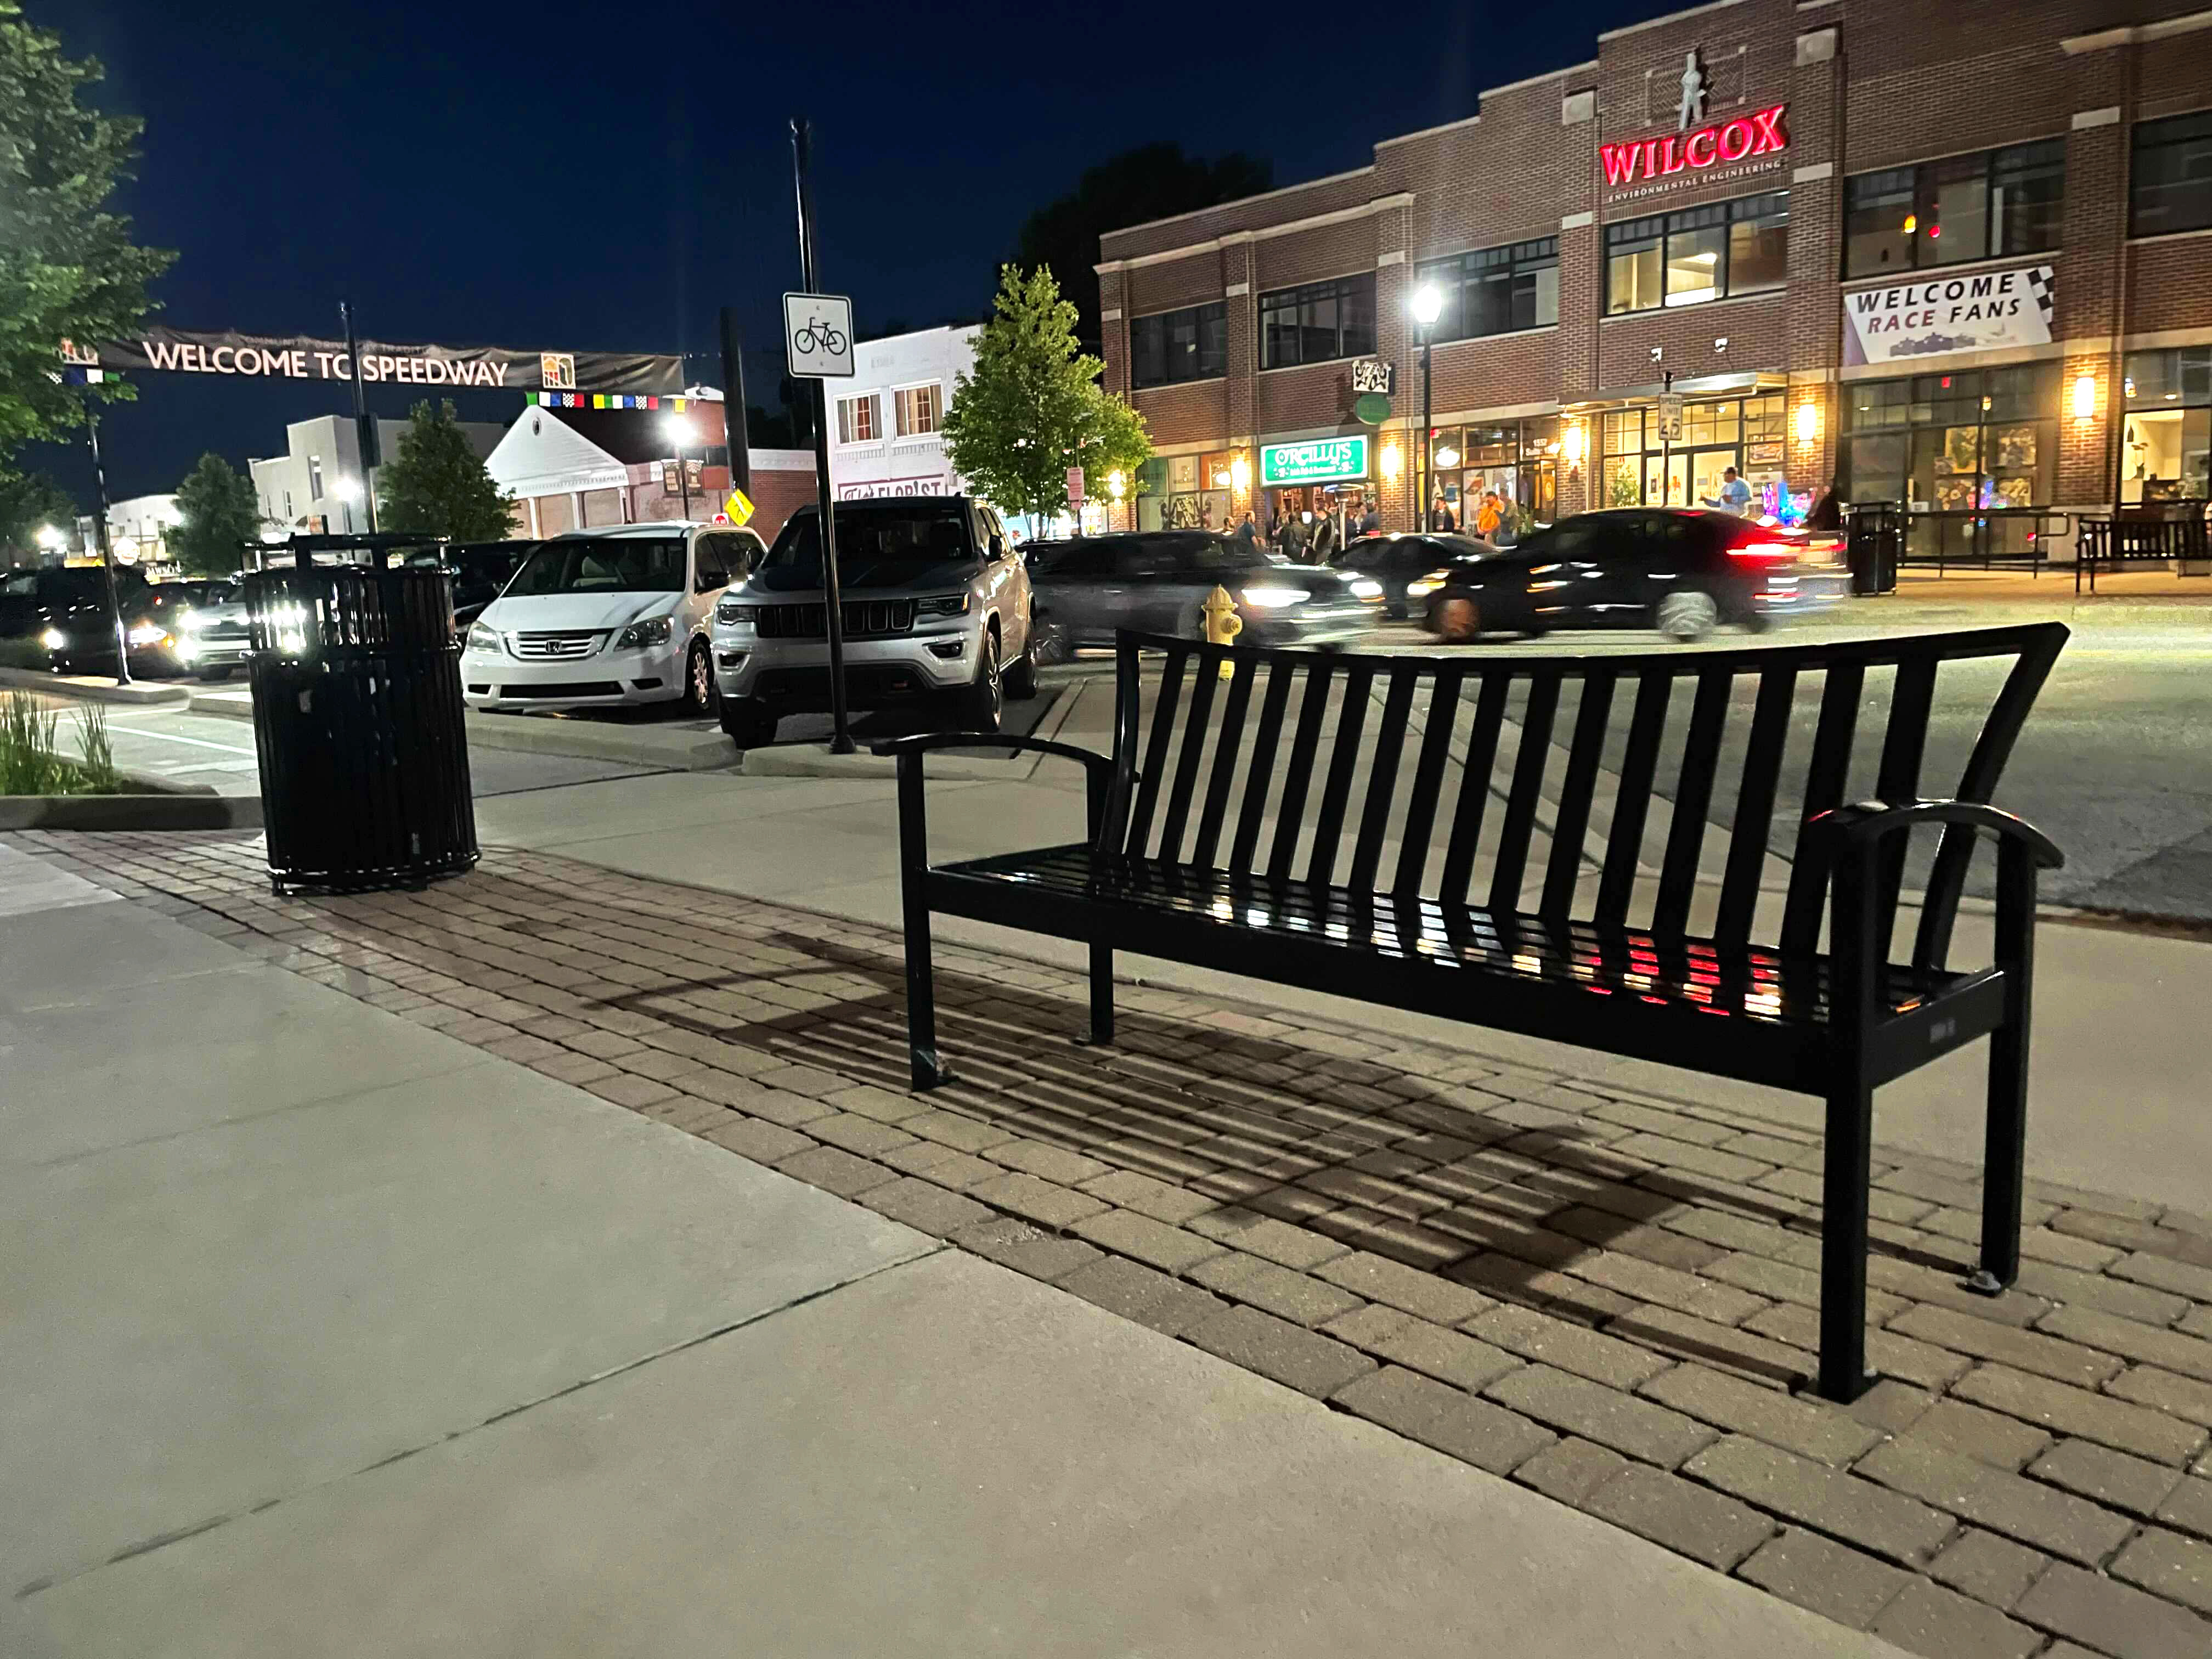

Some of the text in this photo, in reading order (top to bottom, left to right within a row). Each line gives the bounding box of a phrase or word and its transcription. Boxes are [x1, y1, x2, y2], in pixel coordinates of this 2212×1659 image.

[1599, 105, 1784, 187] WILCOX
[1608, 160, 1782, 203] ENVIRONMENTAL ENGINEERING
[1857, 273, 2016, 314] WELCOME
[1867, 298, 2022, 334] RACE FANS
[142, 341, 509, 387] WELCOME TO SPEEDWAY
[1661, 417, 1680, 436] 25
